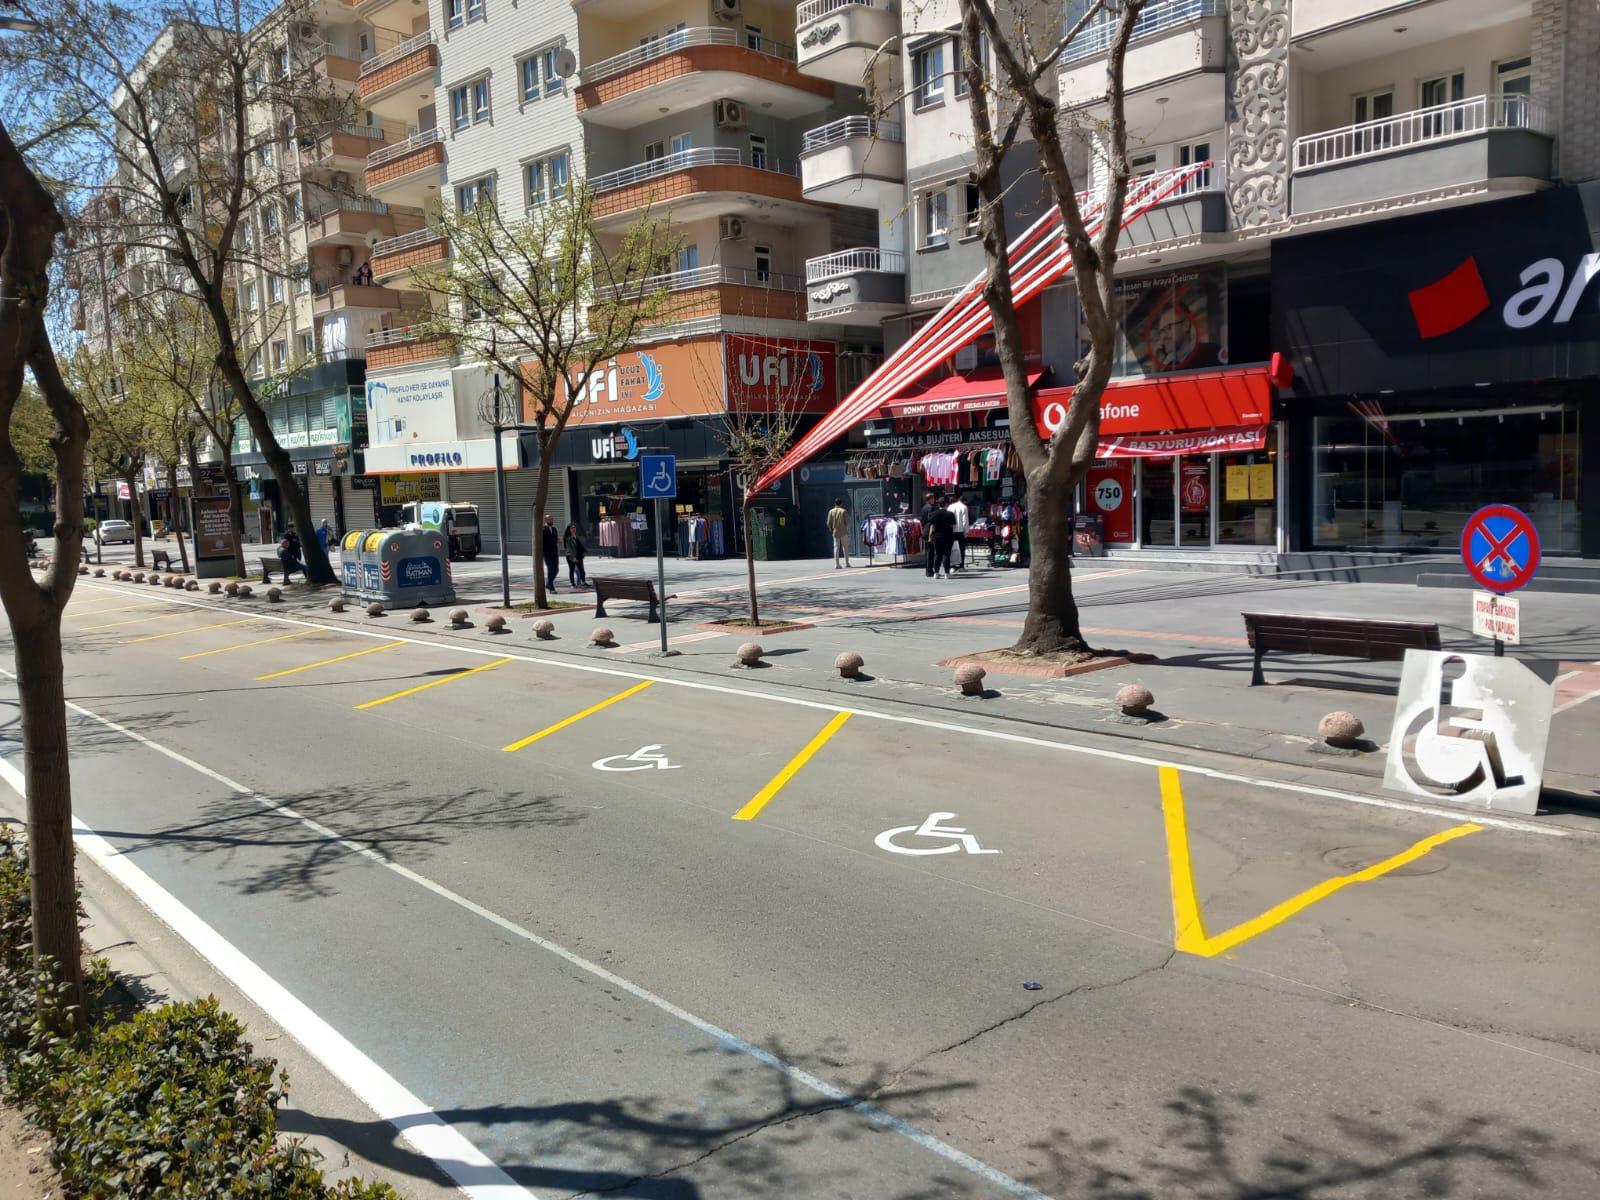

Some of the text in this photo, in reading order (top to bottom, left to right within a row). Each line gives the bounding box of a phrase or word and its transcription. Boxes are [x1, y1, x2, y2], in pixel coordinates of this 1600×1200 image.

[620, 365, 640, 375] UCUZ
[620, 376, 647, 386] FAKAT
[903, 405, 926, 415] BONNY
[929, 401, 961, 413] CONCEPT
[969, 428, 1012, 442] AKSESUA
[591, 431, 616, 460] UFİ
[1097, 487, 1120, 500] 750
